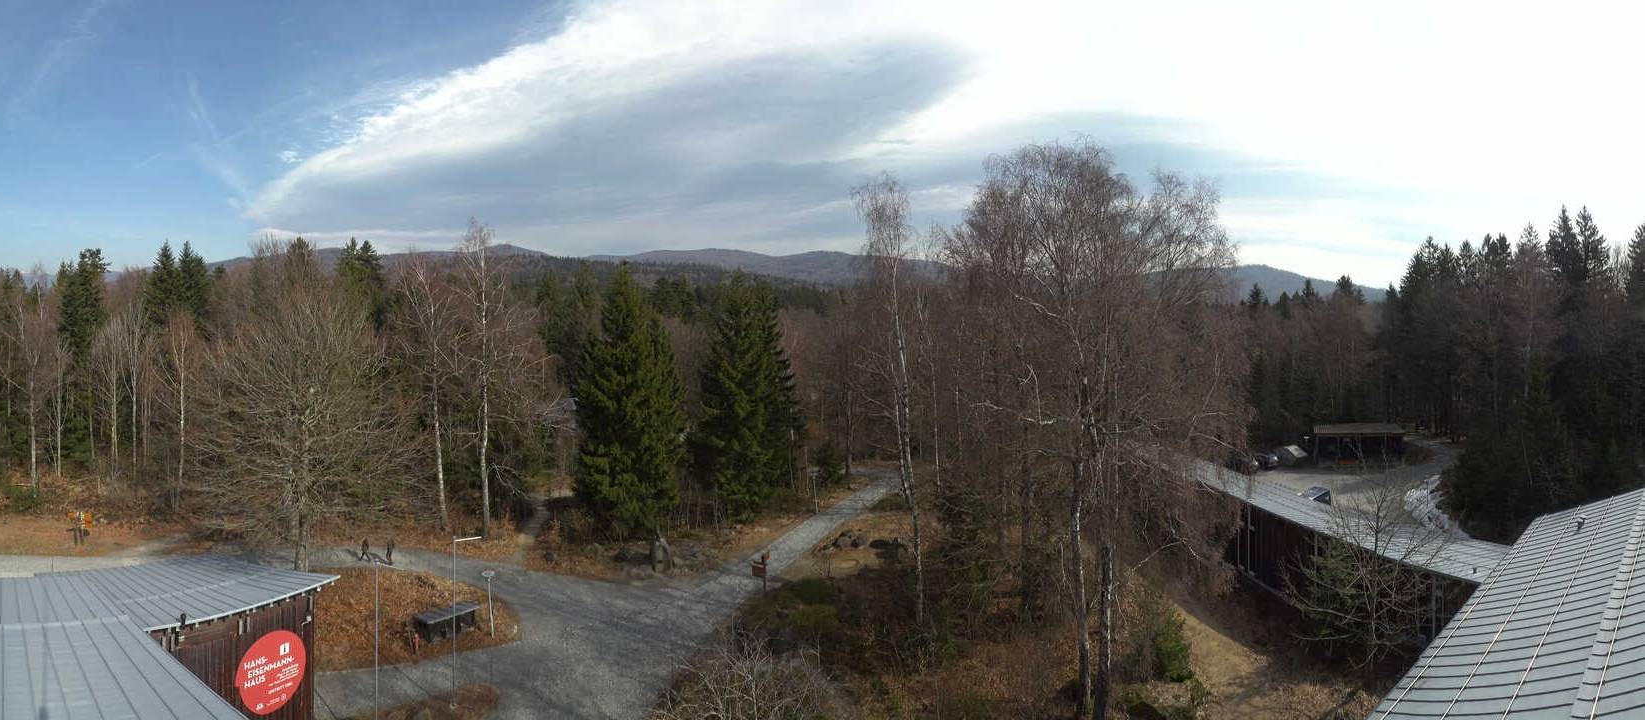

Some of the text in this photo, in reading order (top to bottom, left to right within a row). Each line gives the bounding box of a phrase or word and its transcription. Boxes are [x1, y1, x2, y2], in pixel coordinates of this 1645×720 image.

[244, 656, 268, 670] HANS-
[248, 656, 294, 678] EISENMANN-
[244, 675, 266, 689] HAUS
